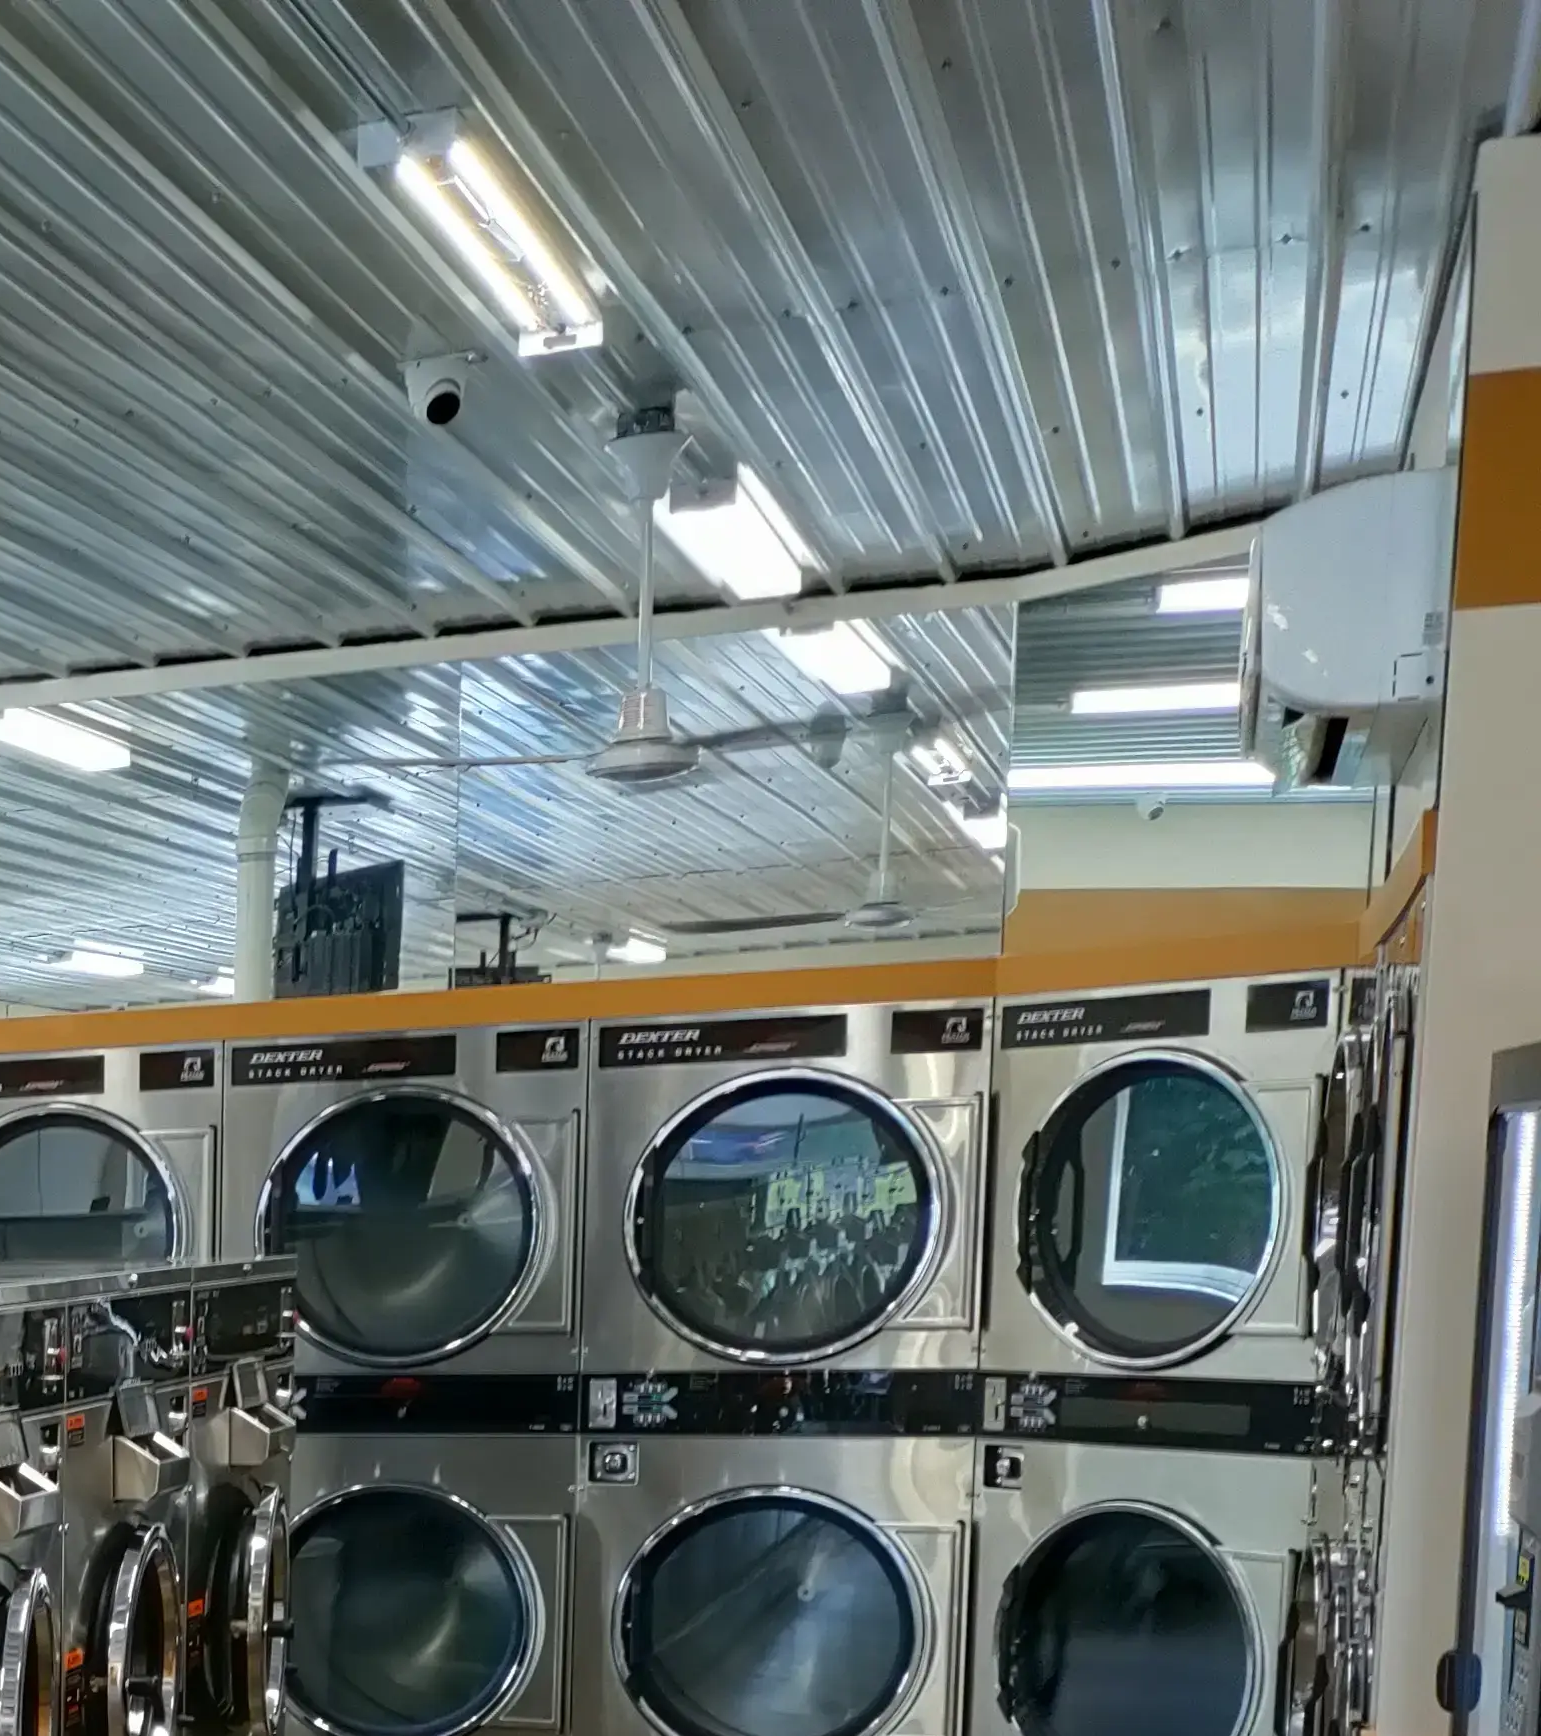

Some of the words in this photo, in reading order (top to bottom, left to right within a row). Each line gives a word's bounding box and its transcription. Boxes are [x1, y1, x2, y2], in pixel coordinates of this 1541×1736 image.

[1017, 1007, 1086, 1025] DEXTER
[618, 1029, 701, 1045] DEXTER
[249, 1049, 324, 1065] DEXTER
